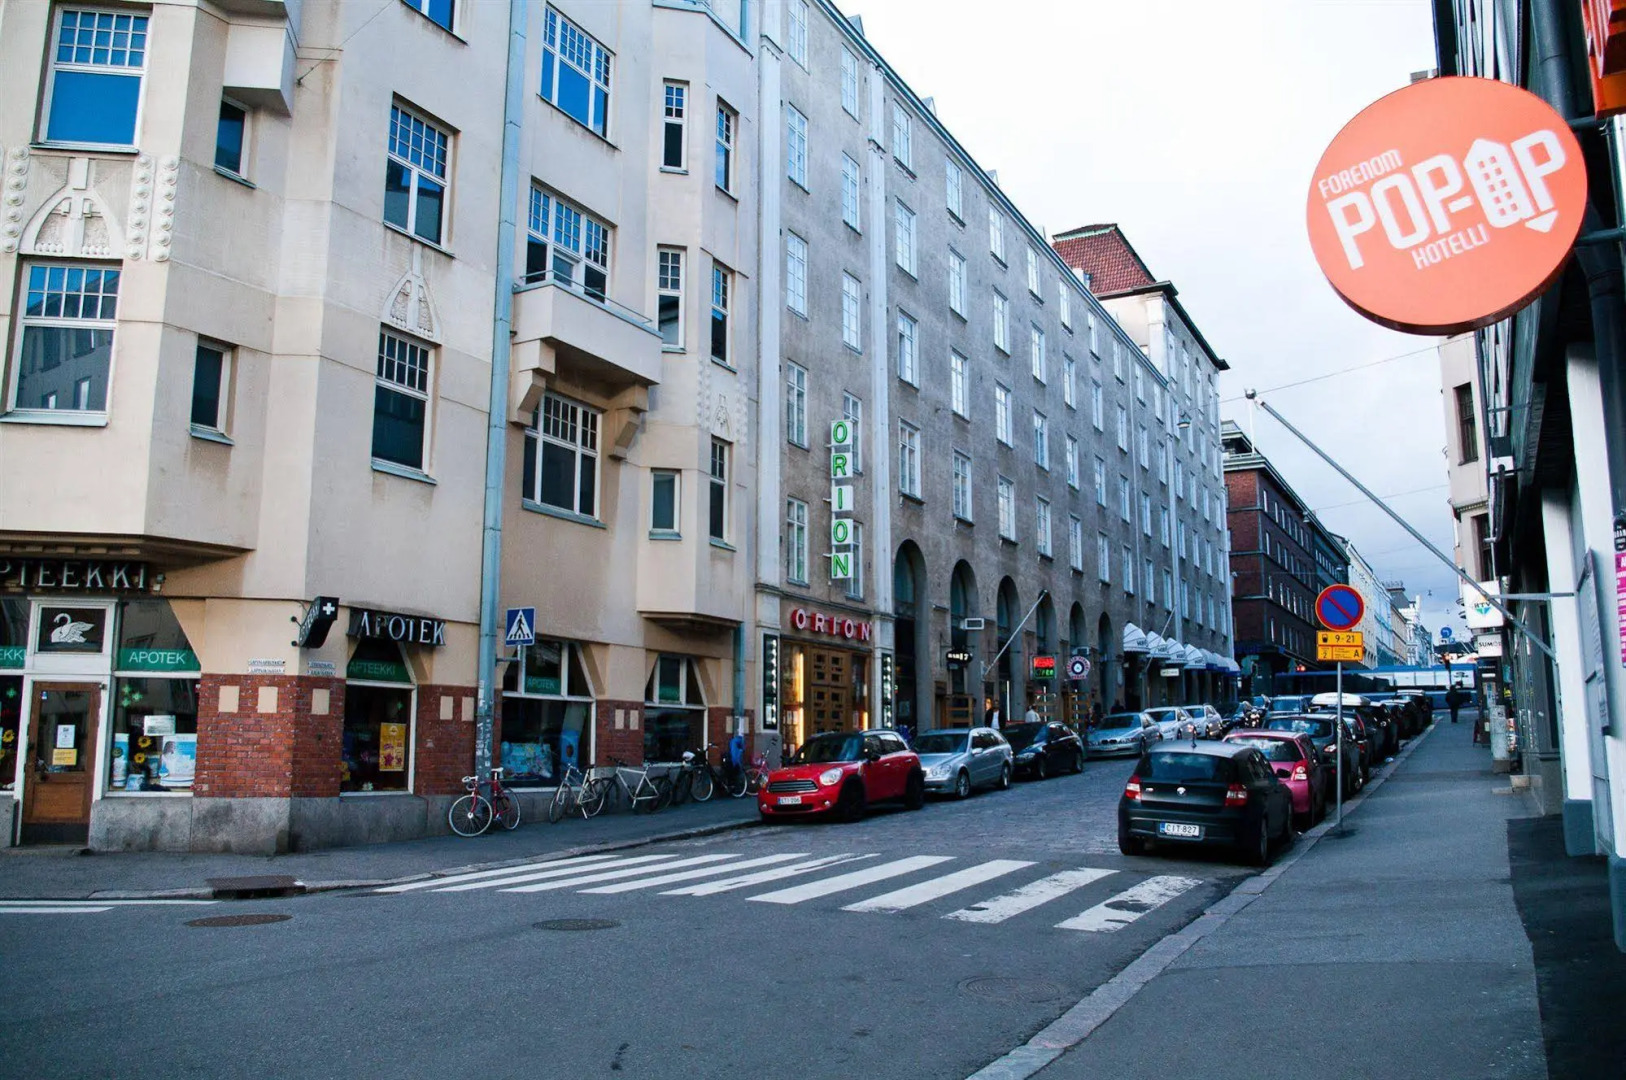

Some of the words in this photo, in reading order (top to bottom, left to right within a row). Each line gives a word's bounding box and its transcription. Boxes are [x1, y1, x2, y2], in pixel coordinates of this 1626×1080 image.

[1326, 129, 1566, 270] POP-UP
[1411, 223, 1488, 270] HOTELLI
[833, 421, 849, 577] ORION
[358, 610, 447, 646] APOTEK
[792, 608, 870, 641] ORION
[128, 651, 186, 664] APOTEK
[349, 661, 396, 676] APTEEKKI
[527, 678, 555, 689] APOTEK
